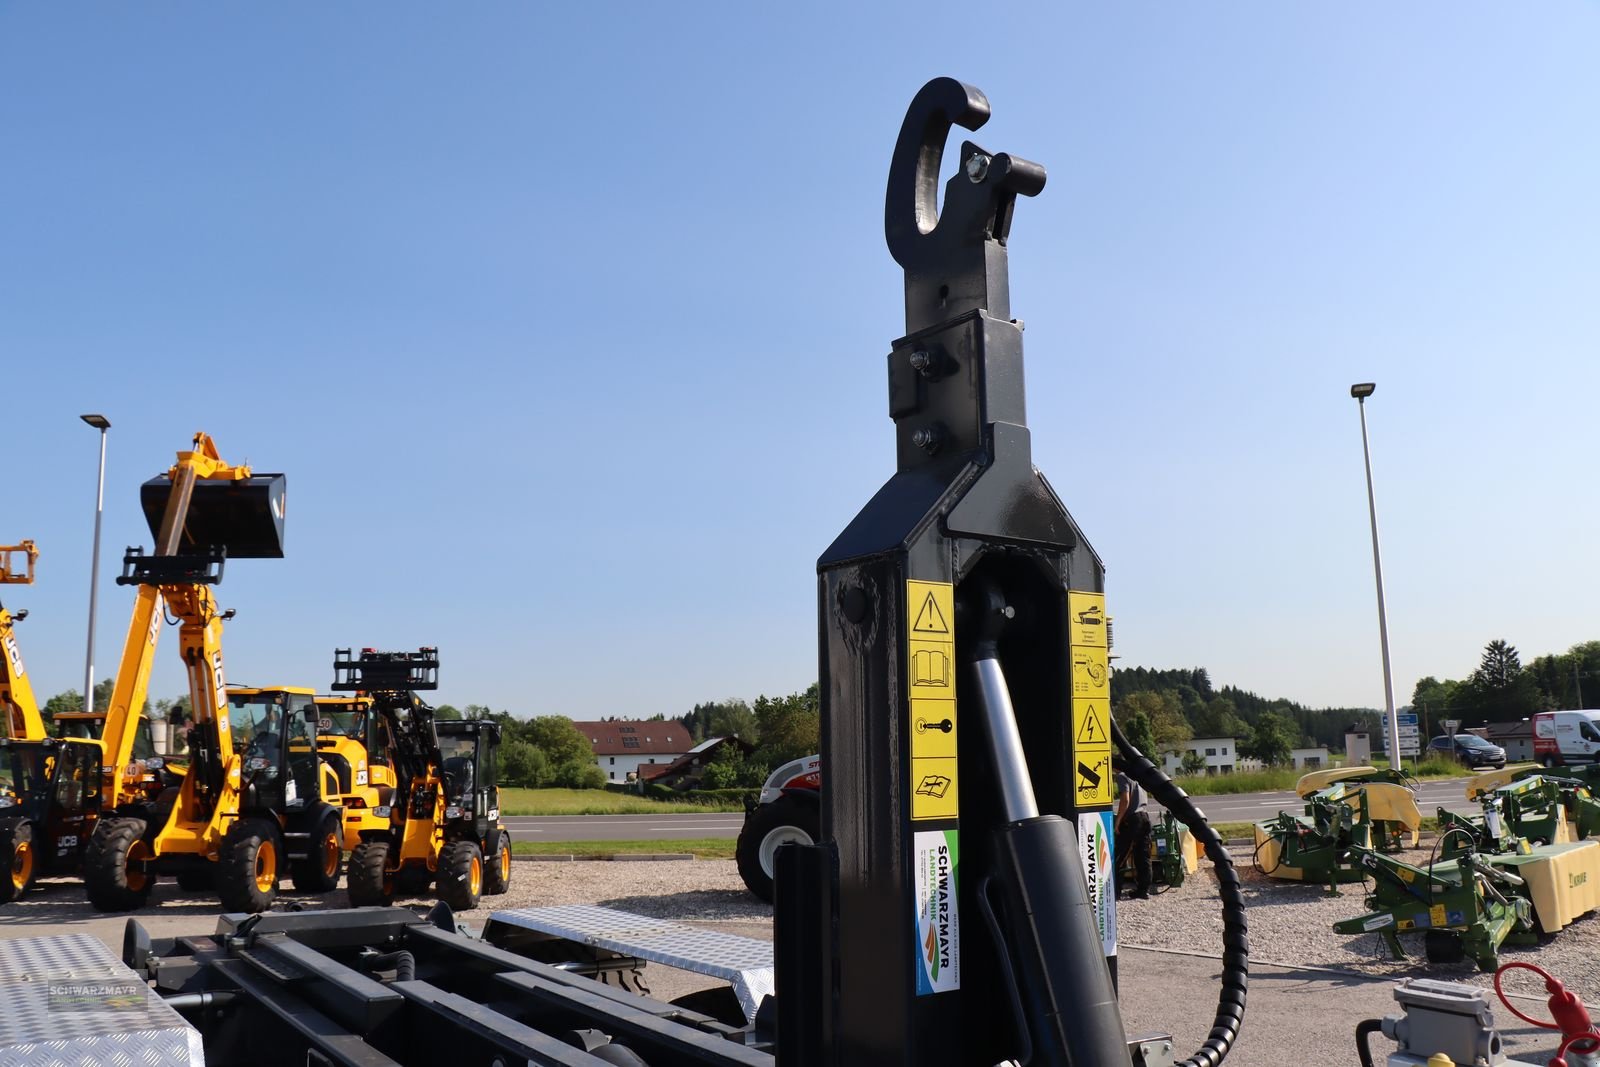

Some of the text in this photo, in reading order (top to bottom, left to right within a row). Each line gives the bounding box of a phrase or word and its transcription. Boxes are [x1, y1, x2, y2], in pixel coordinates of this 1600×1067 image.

[5, 636, 24, 678] JCB
[58, 836, 77, 847] JCB
[929, 848, 937, 921] LANDTECHNIK
[938, 845, 950, 969] SCHWARZMAYR
